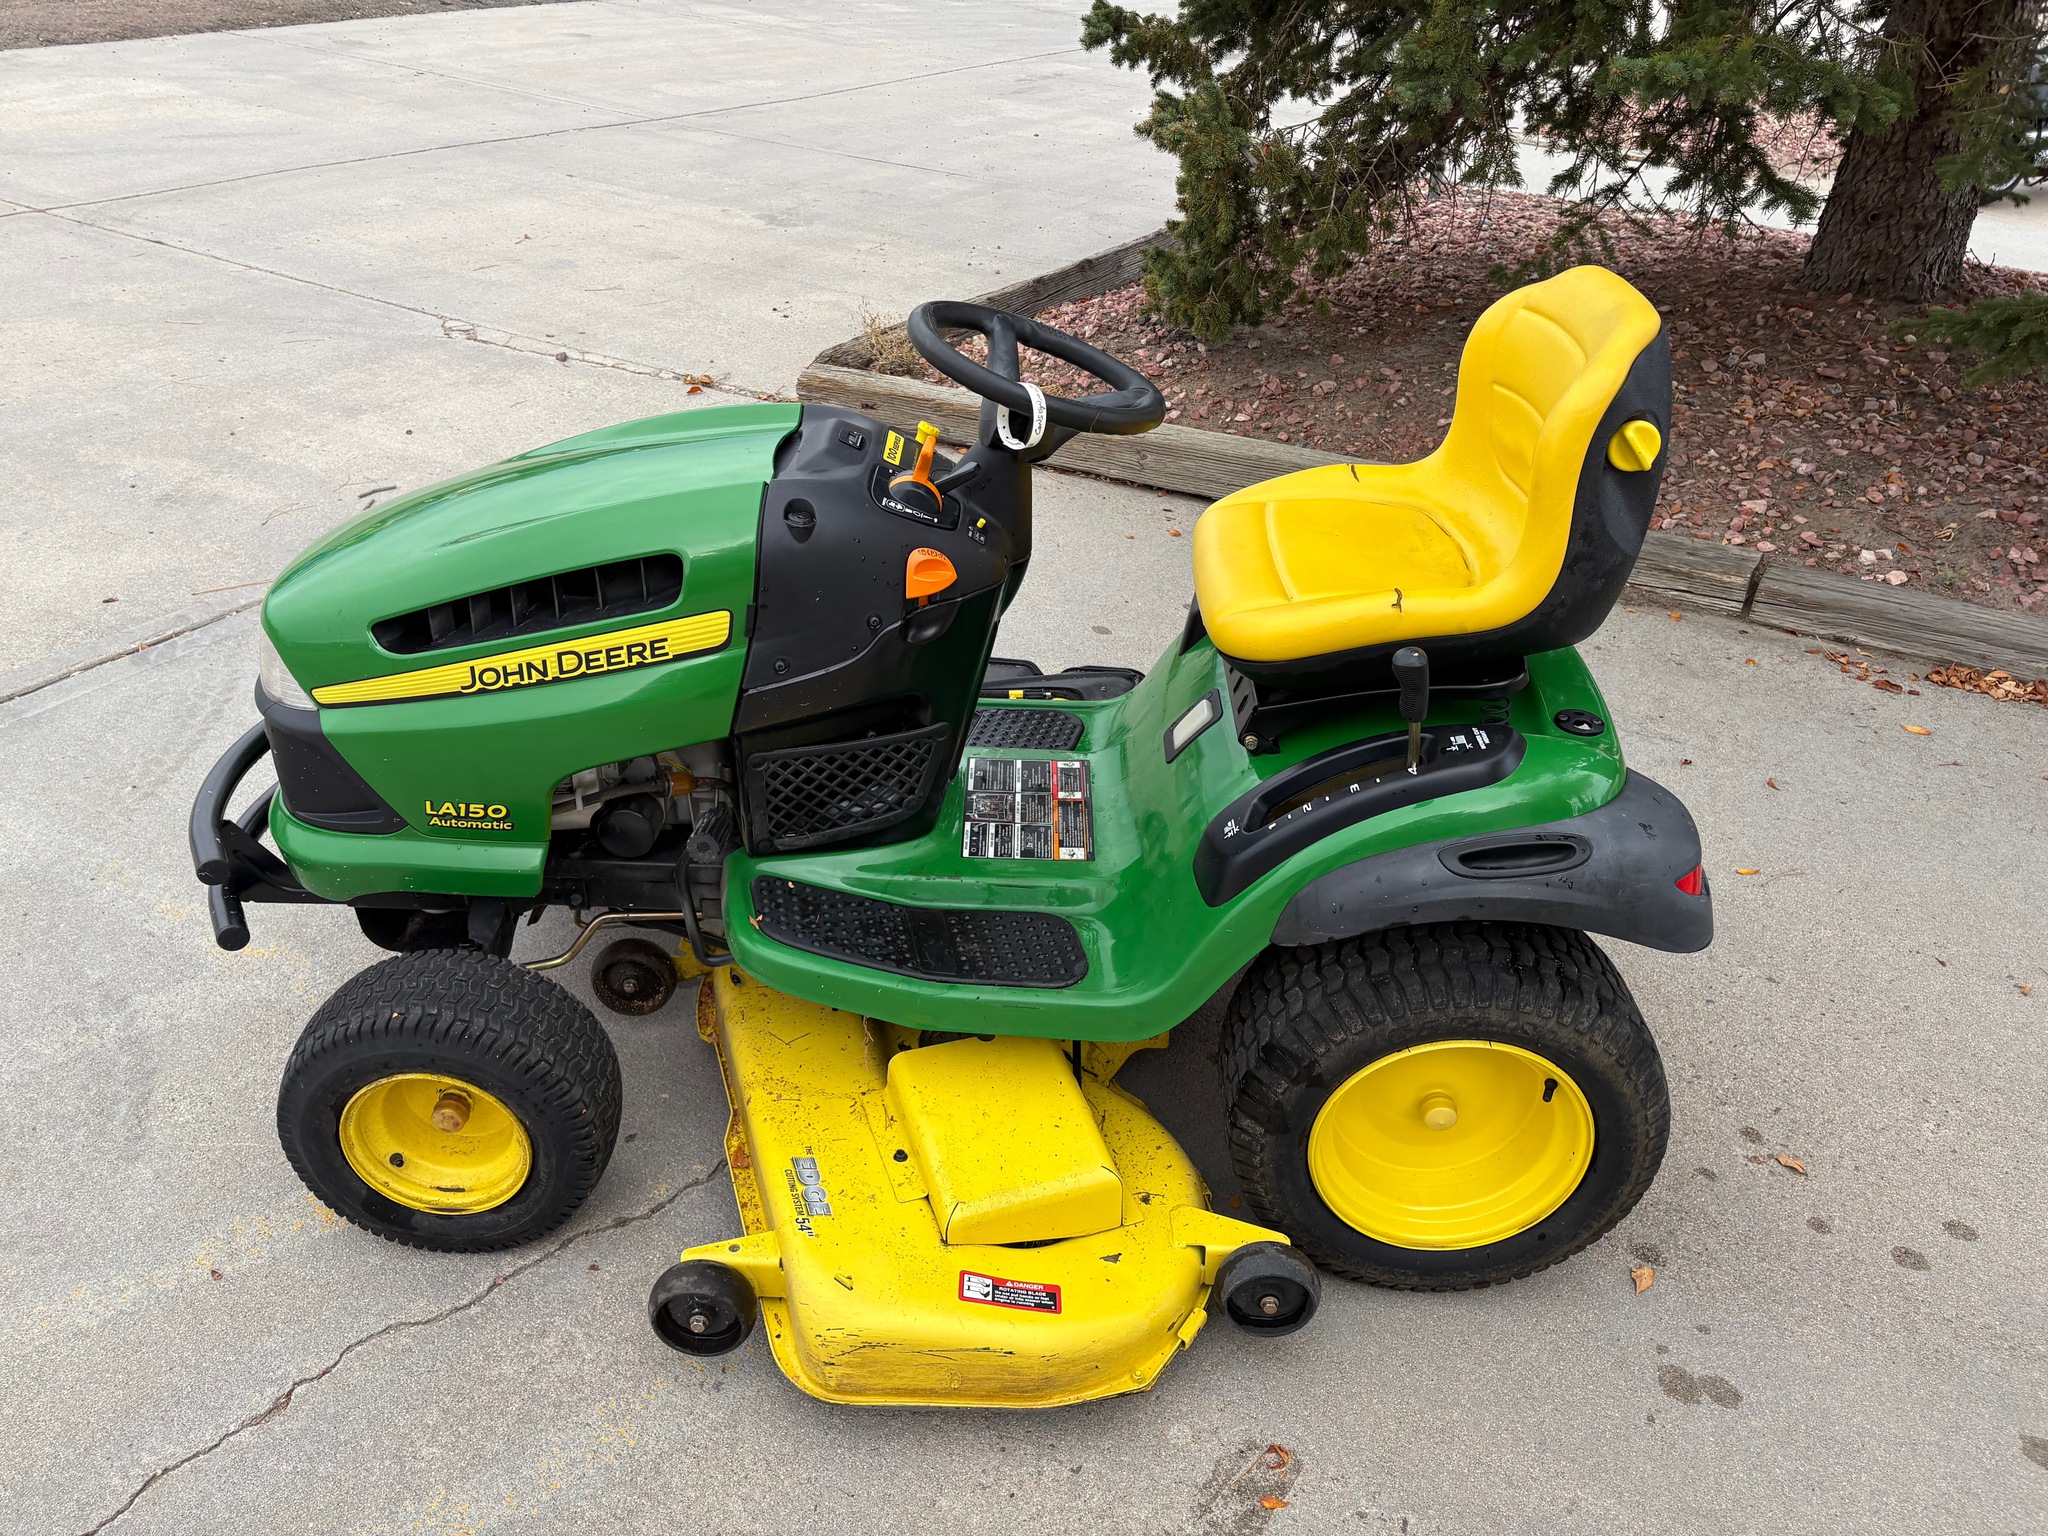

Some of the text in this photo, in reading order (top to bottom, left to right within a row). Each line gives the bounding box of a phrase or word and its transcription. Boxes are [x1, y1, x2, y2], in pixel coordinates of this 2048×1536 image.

[886, 447, 898, 462] 100
[460, 637, 671, 692] JOHN DEERE
[1302, 802, 1312, 813] 2
[1349, 783, 1360, 794] 3
[1407, 765, 1418, 776] 4
[425, 800, 509, 819] LA150
[429, 816, 514, 831] Automatic
[805, 1146, 814, 1155] THE
[785, 1169, 799, 1193] CUTTING
[791, 1156, 833, 1217] EDGE
[791, 1192, 805, 1216] SYSTEM
[998, 1287, 1027, 1295] ROTATING
[1013, 1282, 1044, 1290] DANGER
